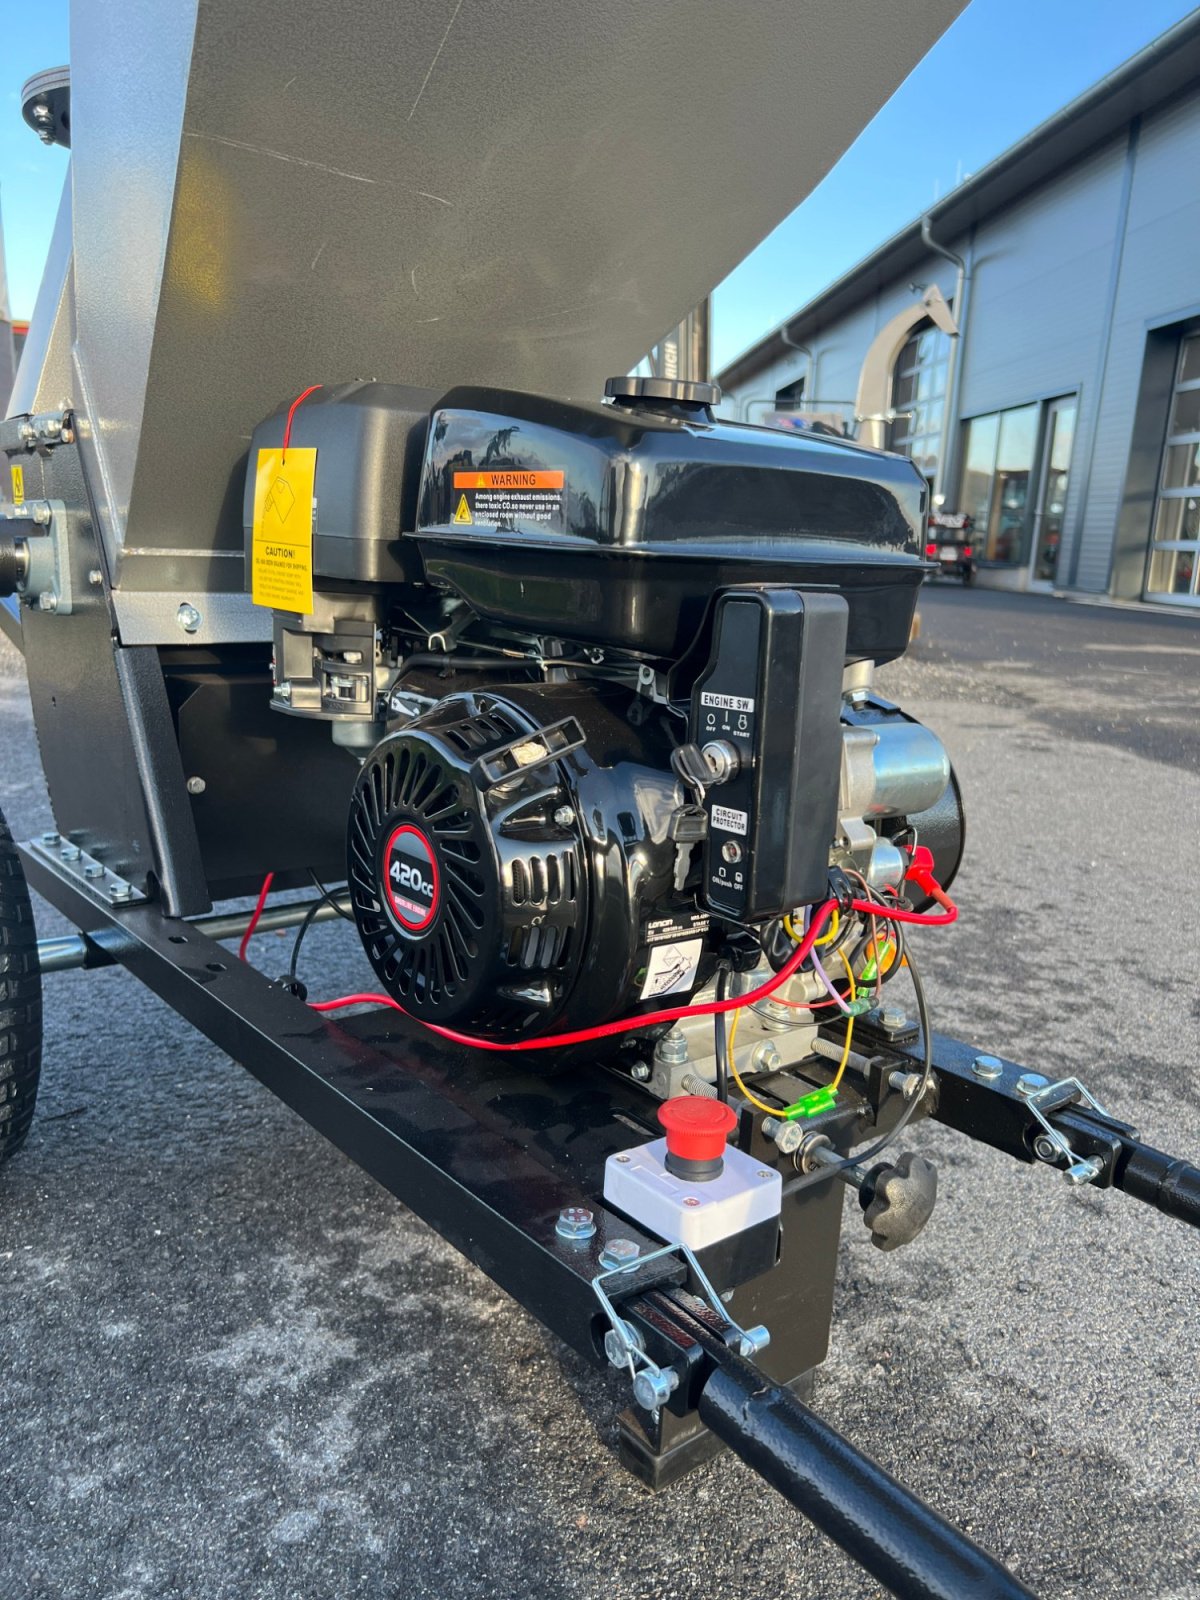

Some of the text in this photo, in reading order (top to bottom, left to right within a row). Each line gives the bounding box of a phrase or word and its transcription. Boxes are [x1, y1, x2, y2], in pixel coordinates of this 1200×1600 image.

[491, 474, 536, 486] WARNING
[475, 493, 492, 501] Among
[493, 493, 510, 502] engine
[511, 493, 531, 501] exhaust
[475, 501, 488, 509] there
[489, 501, 501, 509] toxic
[546, 502, 552, 510] in
[475, 511, 499, 519] enclosed
[514, 511, 536, 520] without
[536, 511, 552, 521] good
[704, 694, 734, 708] ENGINE
[733, 730, 750, 738] START
[716, 808, 743, 822] CIRCUIT
[712, 815, 745, 831] PROTECTOR
[390, 861, 434, 898] 420cc
[733, 882, 743, 891] OFF
